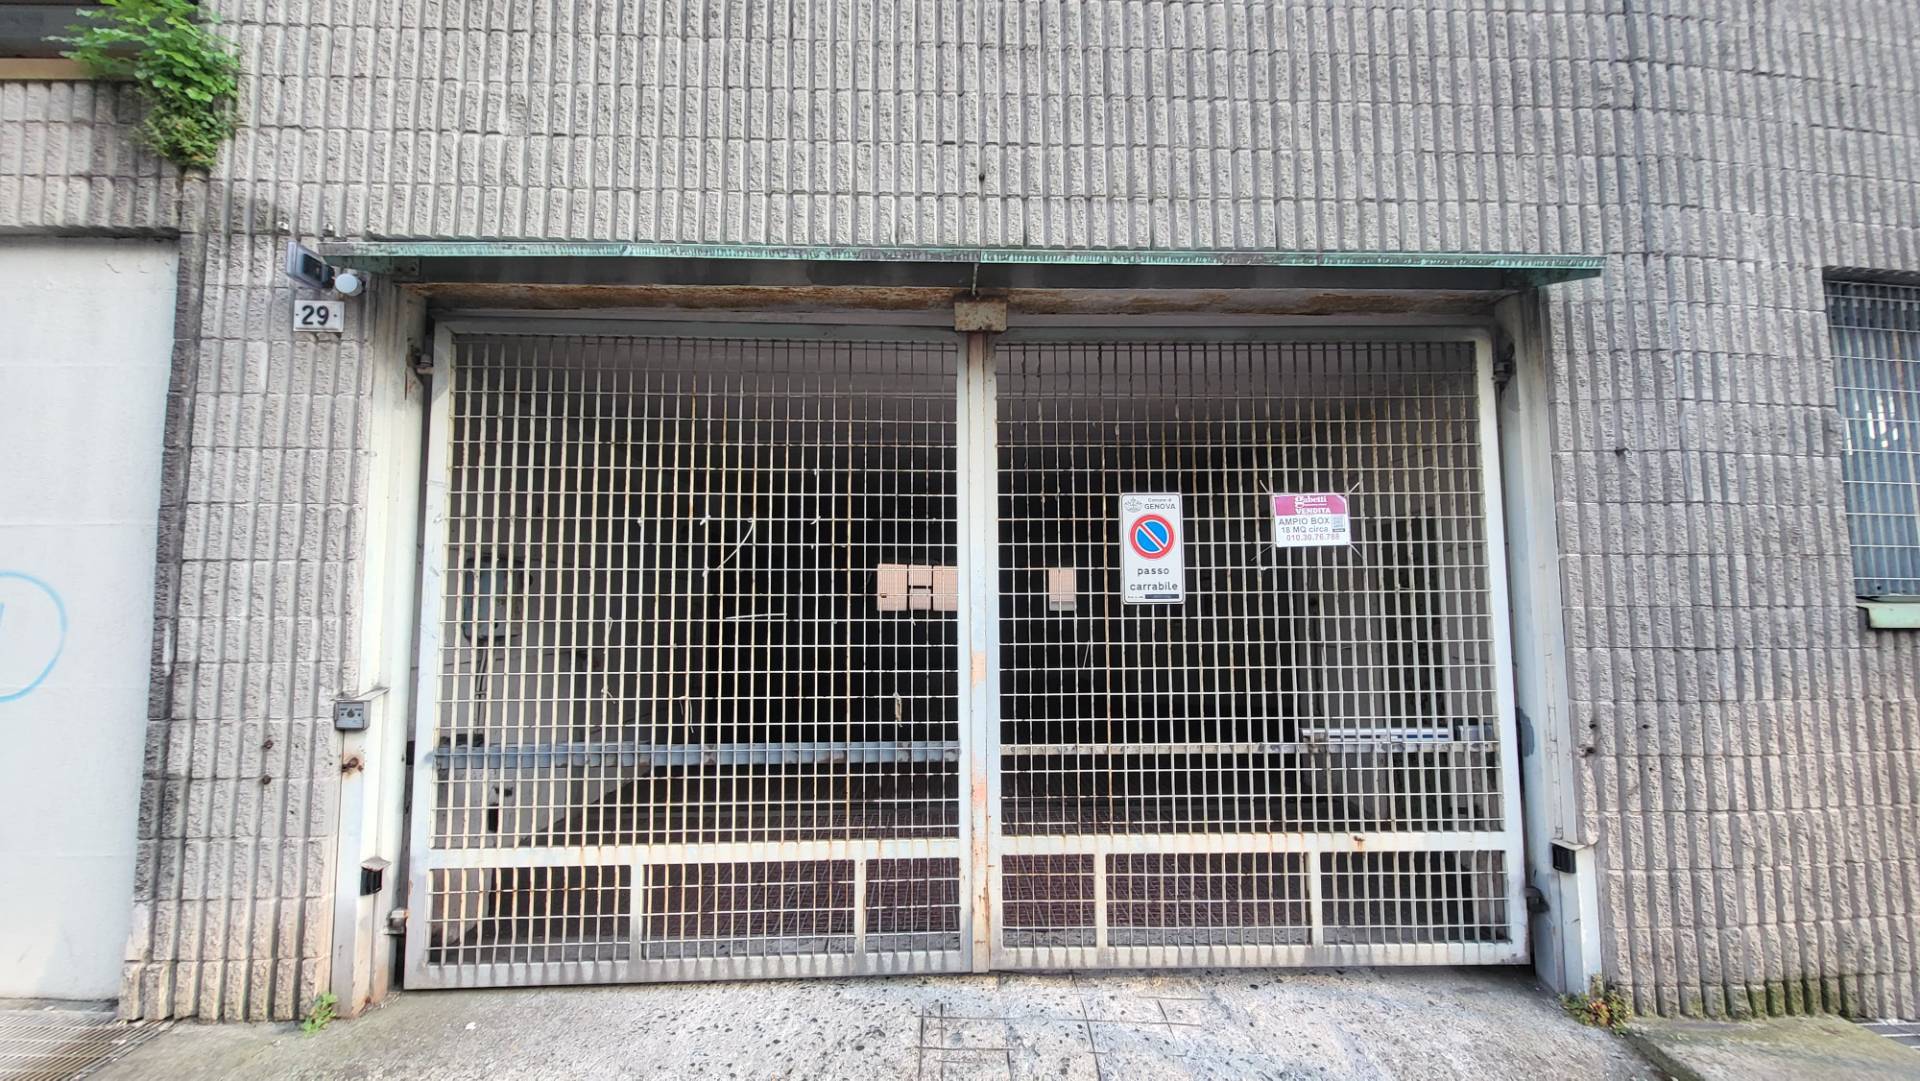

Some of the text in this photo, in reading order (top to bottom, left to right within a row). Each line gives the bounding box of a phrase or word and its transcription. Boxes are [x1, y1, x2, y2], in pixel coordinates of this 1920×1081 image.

[302, 305, 329, 326] 29
[1279, 517, 1330, 525] AMPIO BOX
[1309, 525, 1329, 533] circa
[1137, 568, 1170, 576] passo
[1130, 581, 1178, 591] carrabile
